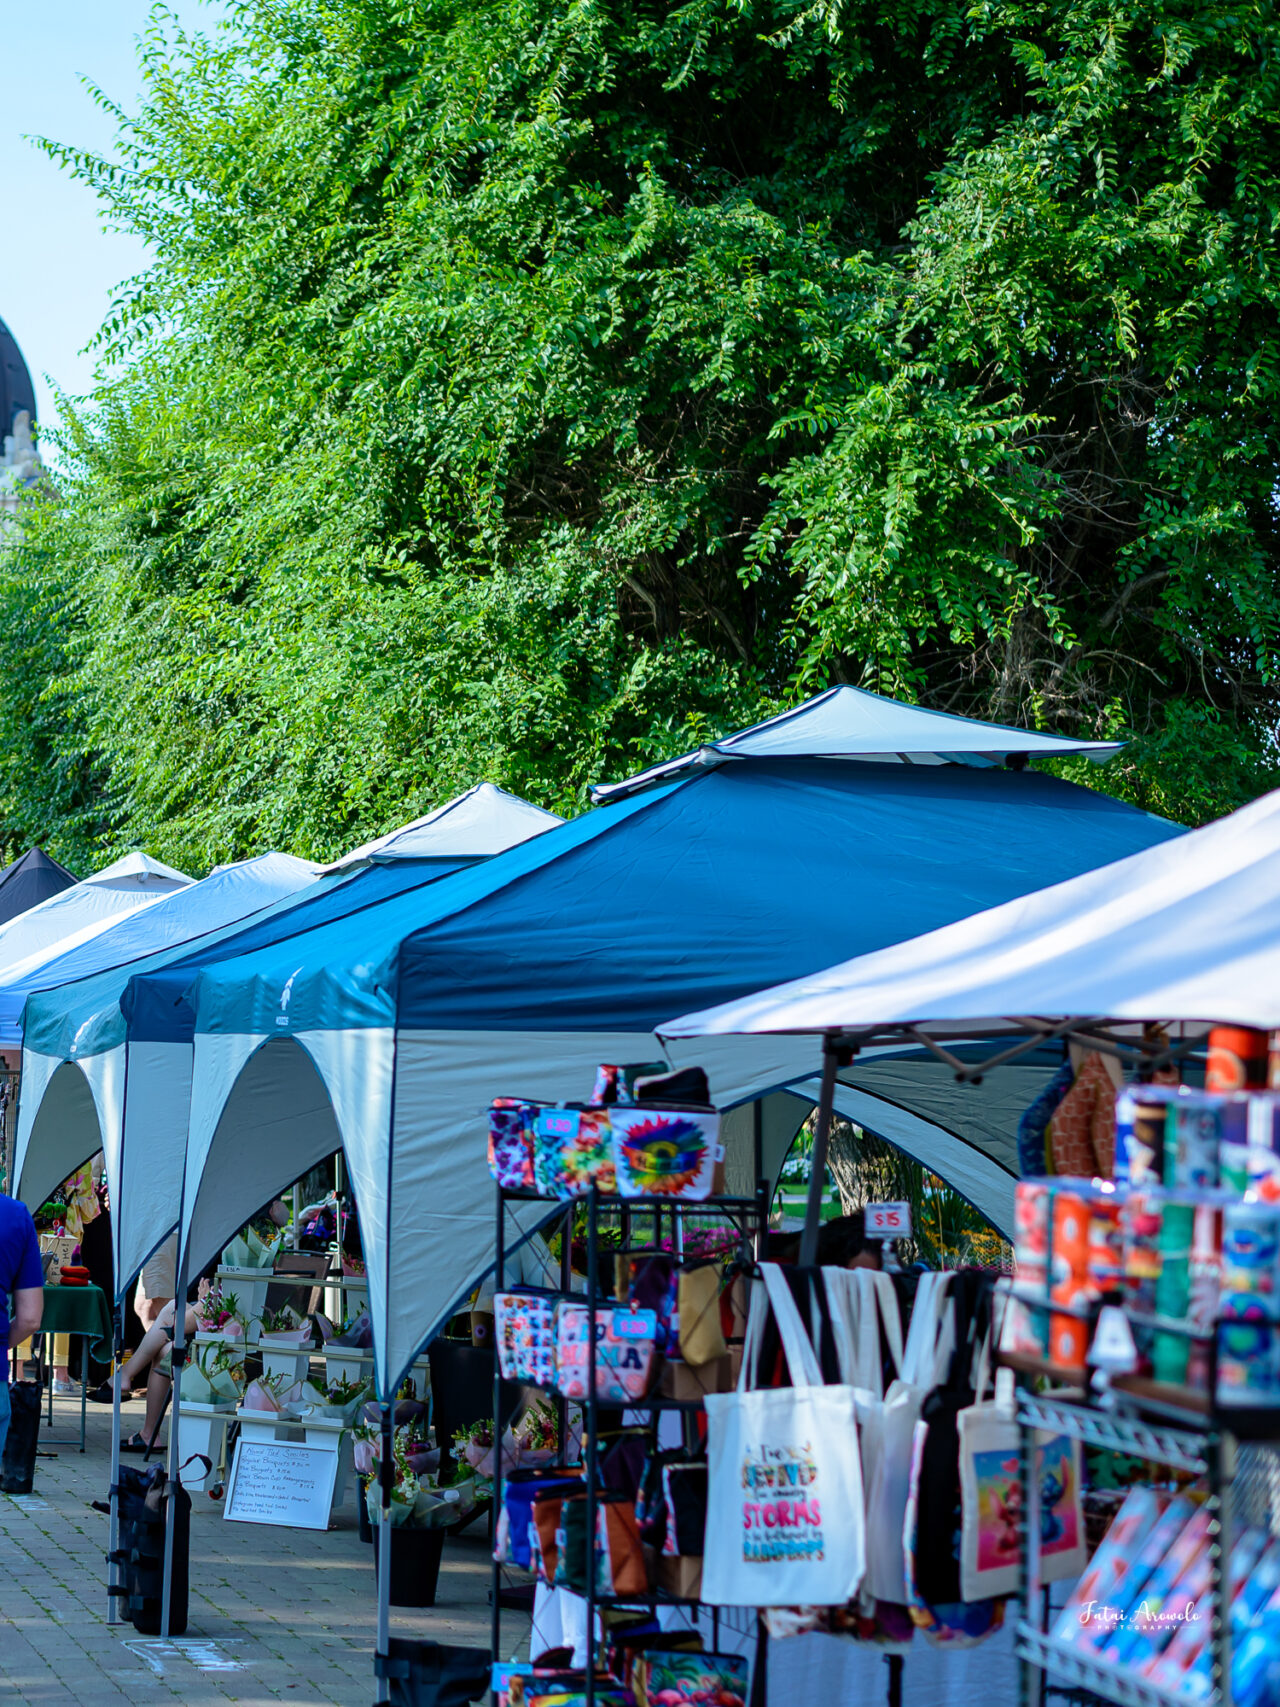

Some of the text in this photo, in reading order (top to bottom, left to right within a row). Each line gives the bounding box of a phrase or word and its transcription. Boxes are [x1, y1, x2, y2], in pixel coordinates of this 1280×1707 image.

[546, 1118, 572, 1132] $20
[874, 1210, 901, 1227] $15
[742, 1499, 822, 1530] STORMS
